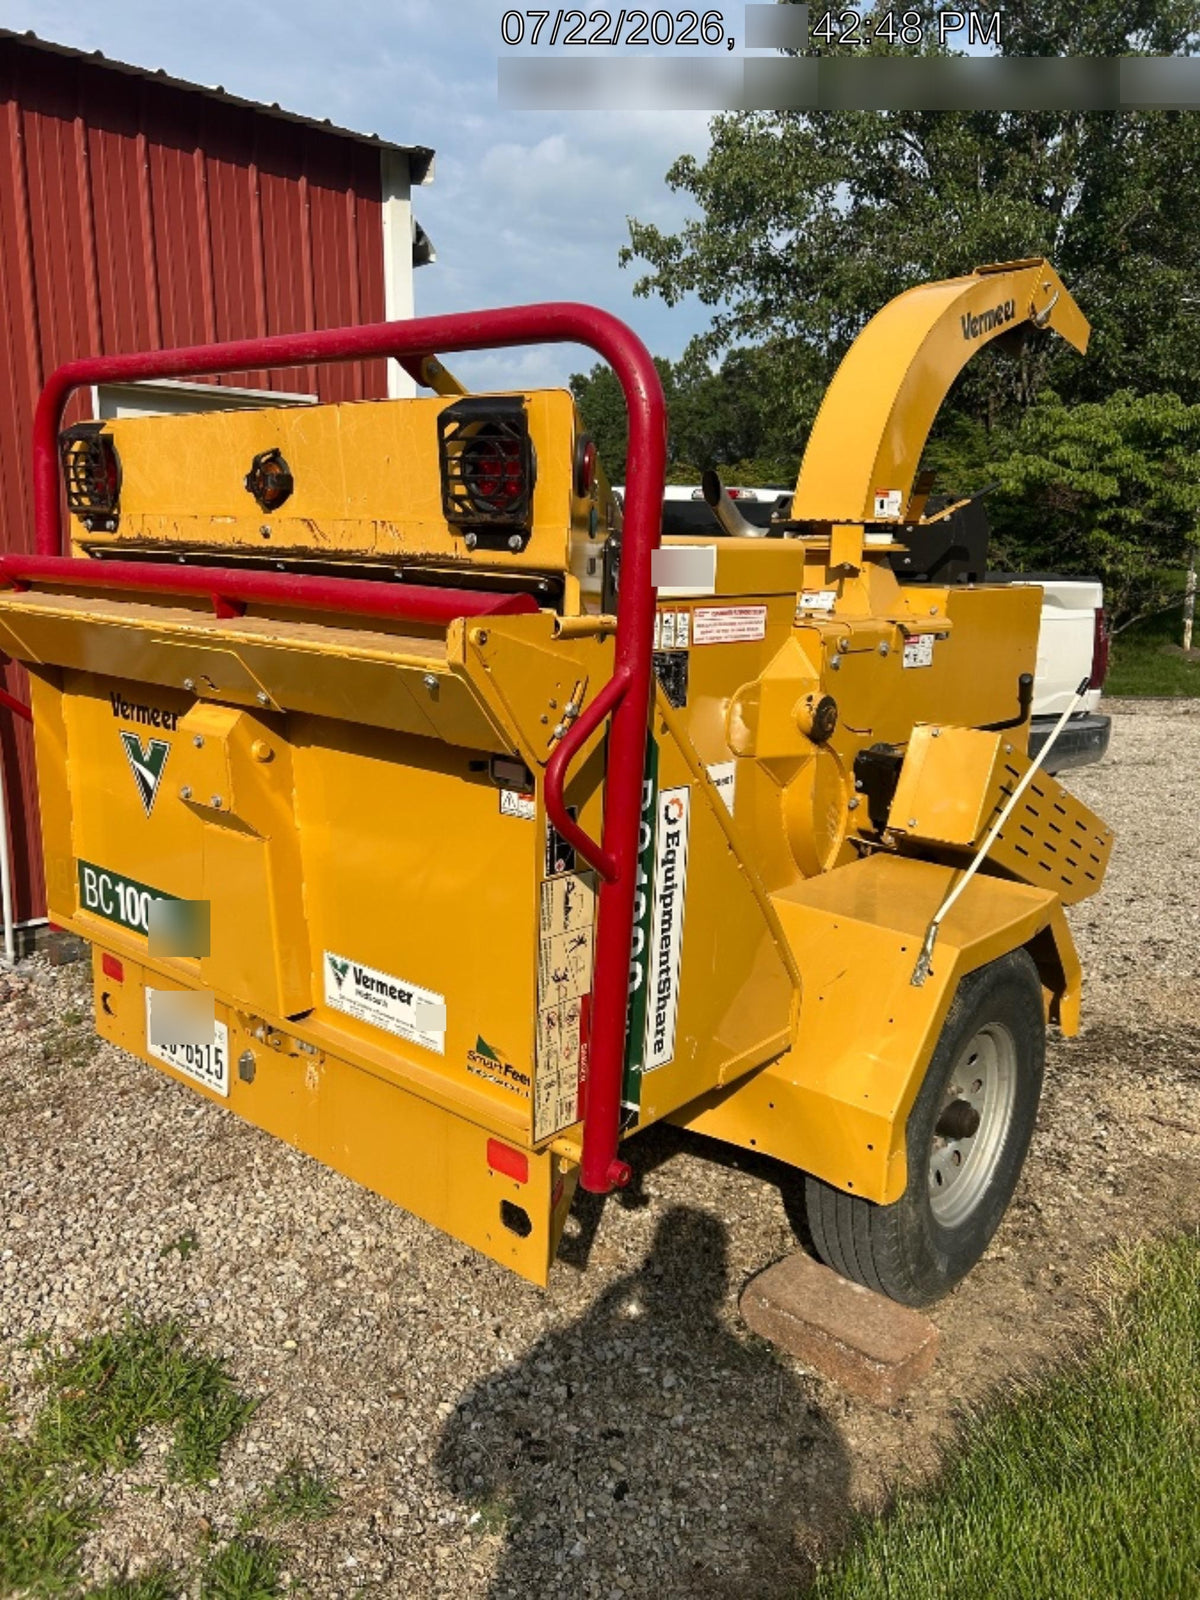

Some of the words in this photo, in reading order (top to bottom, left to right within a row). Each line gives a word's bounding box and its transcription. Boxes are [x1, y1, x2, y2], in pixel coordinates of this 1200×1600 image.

[961, 299, 1016, 340] Vermeer
[110, 692, 178, 731] Vermeer
[653, 829, 681, 1055] EquipmentShare
[353, 966, 413, 1006] Vermeer
